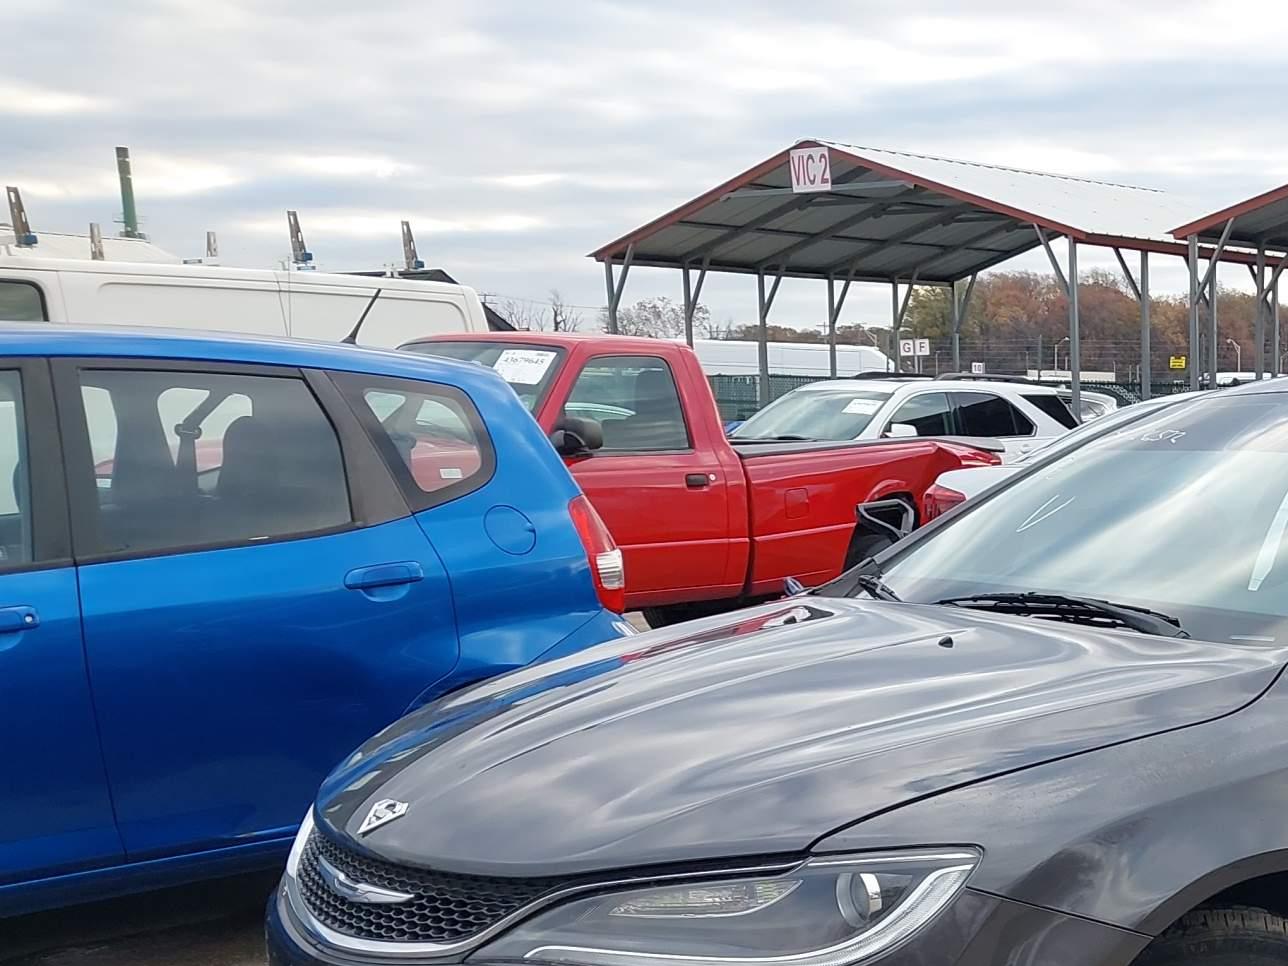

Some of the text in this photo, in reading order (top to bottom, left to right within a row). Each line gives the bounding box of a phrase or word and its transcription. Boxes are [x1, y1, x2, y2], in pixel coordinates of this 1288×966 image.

[791, 153, 829, 186] VIC 2
[902, 342, 911, 353] G
[919, 341, 926, 353] F
